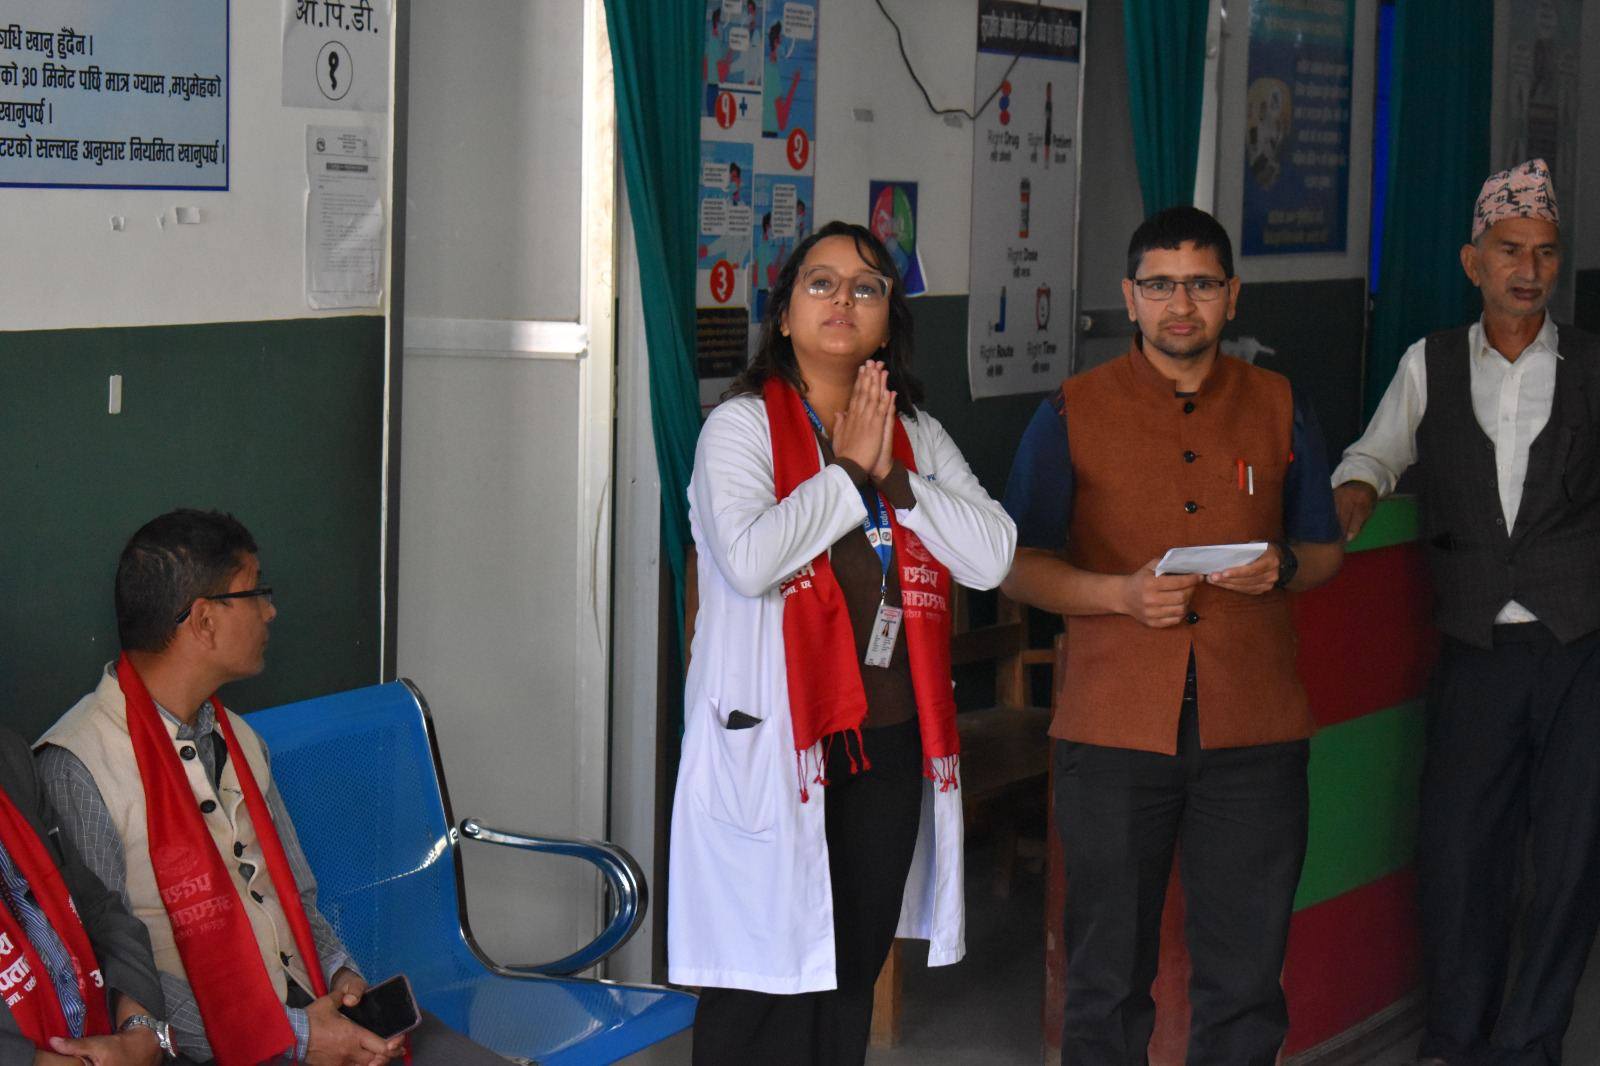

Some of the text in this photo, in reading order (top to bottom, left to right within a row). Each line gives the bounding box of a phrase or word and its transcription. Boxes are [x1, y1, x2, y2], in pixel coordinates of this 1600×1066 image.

[26, 31, 54, 58] खानु
[57, 27, 86, 59] हुँदैन
[22, 67, 37, 88] ३०
[42, 62, 76, 88] मिनेट
[79, 66, 102, 92] पछि
[105, 71, 130, 92] मात्र
[133, 74, 165, 94] ग्यास
[328, 51, 339, 90] १
[36, 138, 79, 160] सल्लाह
[83, 140, 126, 166] अनुसार
[130, 137, 175, 162] नियमित
[178, 140, 219, 168] खानुपर्छ
[1004, 131, 1019, 150] Drug
